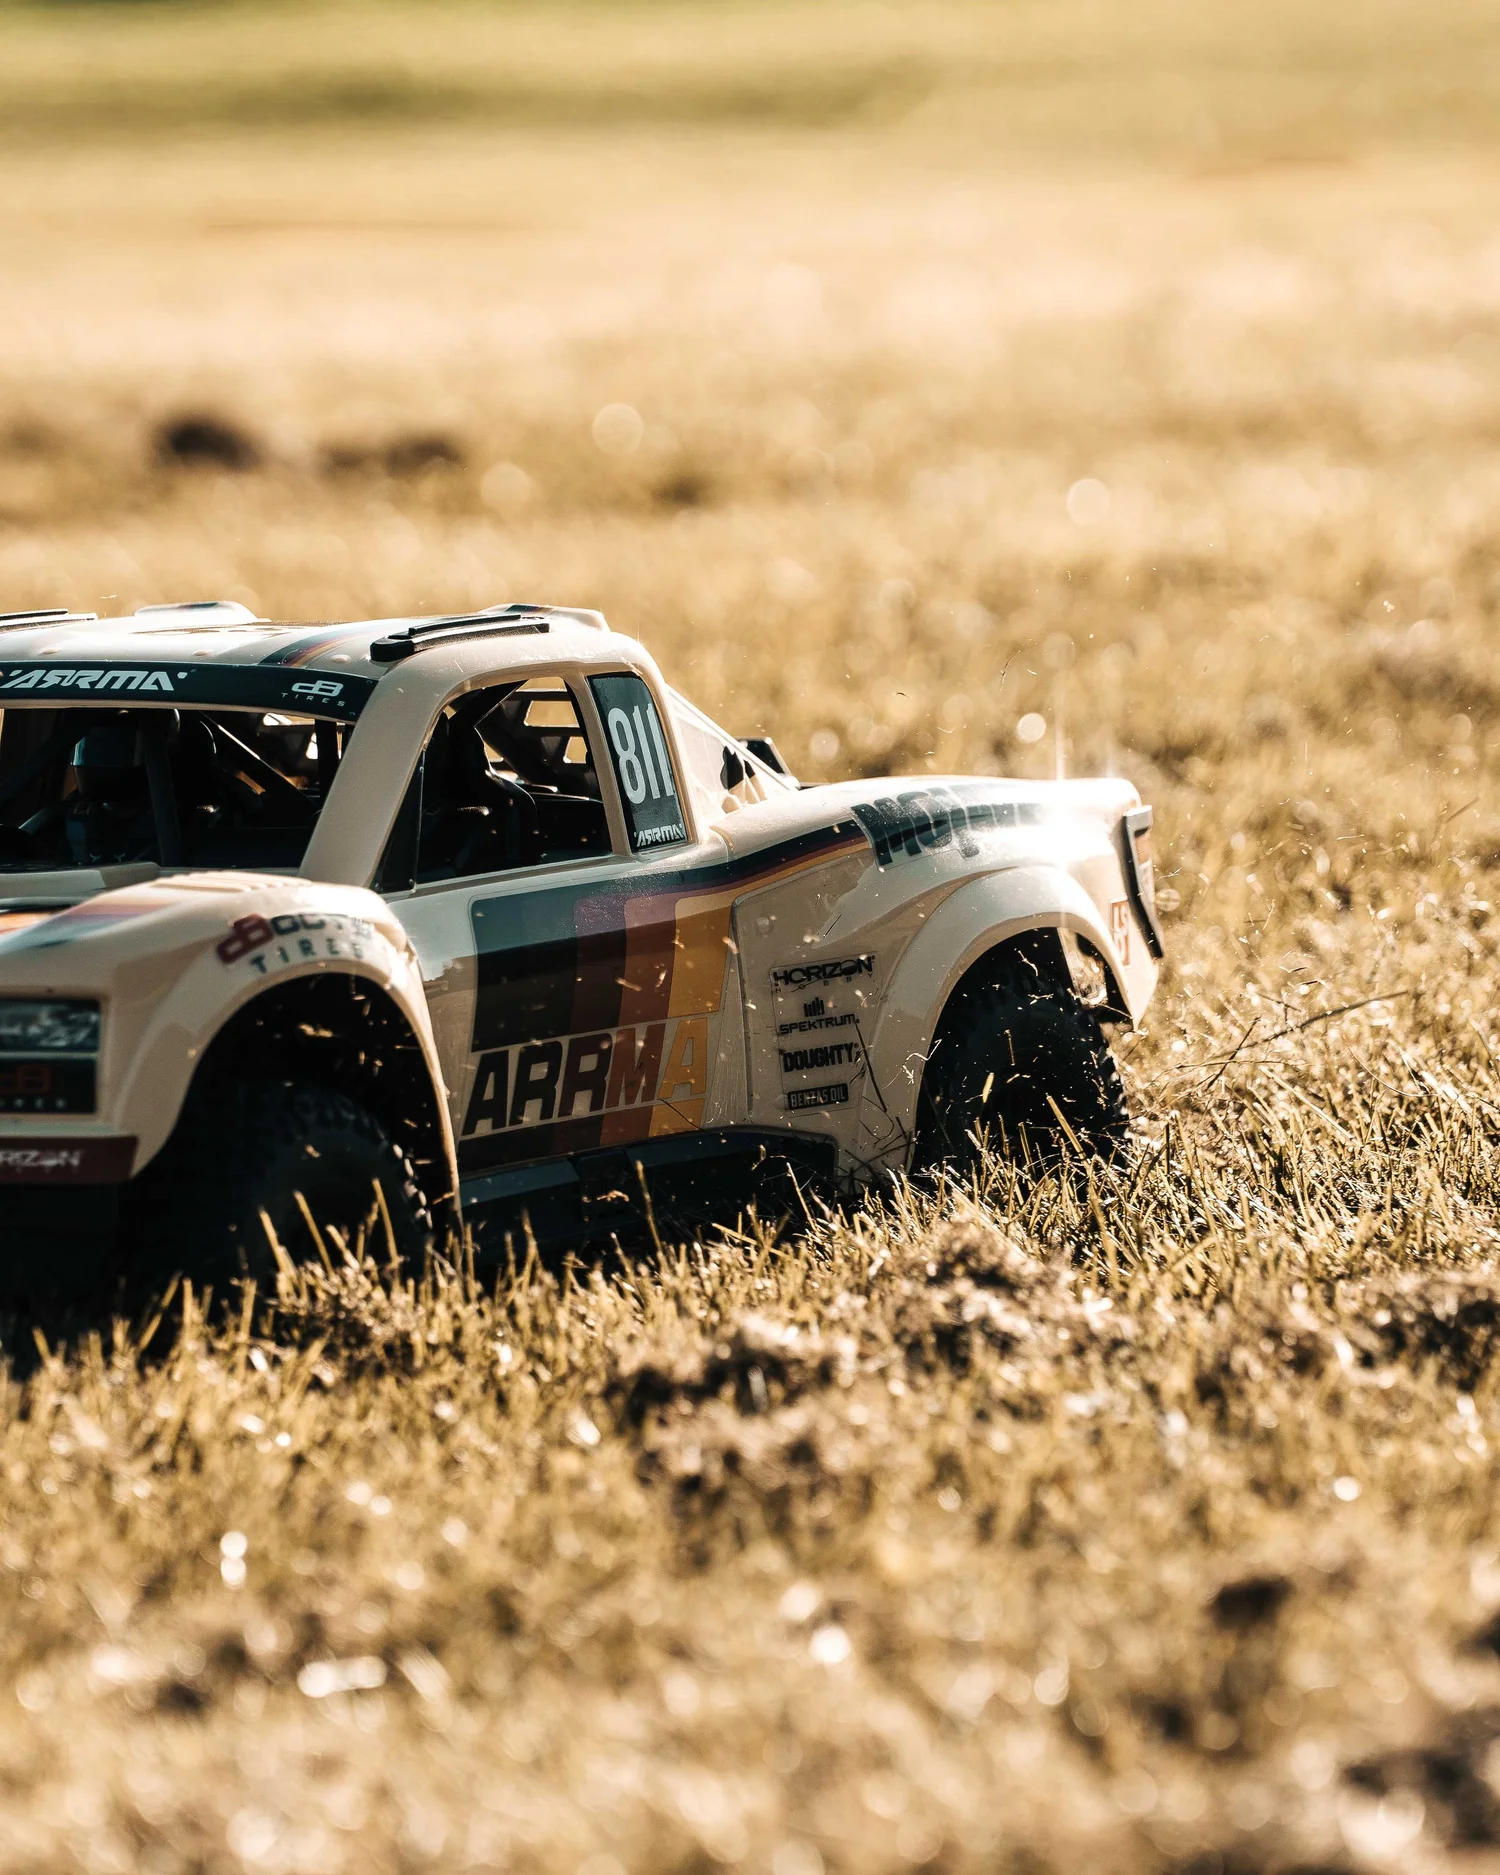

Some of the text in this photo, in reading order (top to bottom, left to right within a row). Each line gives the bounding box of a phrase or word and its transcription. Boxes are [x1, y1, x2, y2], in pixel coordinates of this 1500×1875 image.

[0, 669, 176, 691] ARRMA
[281, 692, 346, 707] TIRES
[608, 703, 674, 804] 811
[635, 823, 684, 847] ARRMA
[773, 955, 873, 986] HORIZON
[779, 1013, 856, 1035] SPEKTRUM
[783, 1042, 855, 1073] DOUGHTY
[461, 1017, 708, 1136] ARRMA
[830, 1085, 846, 1102] OIL
